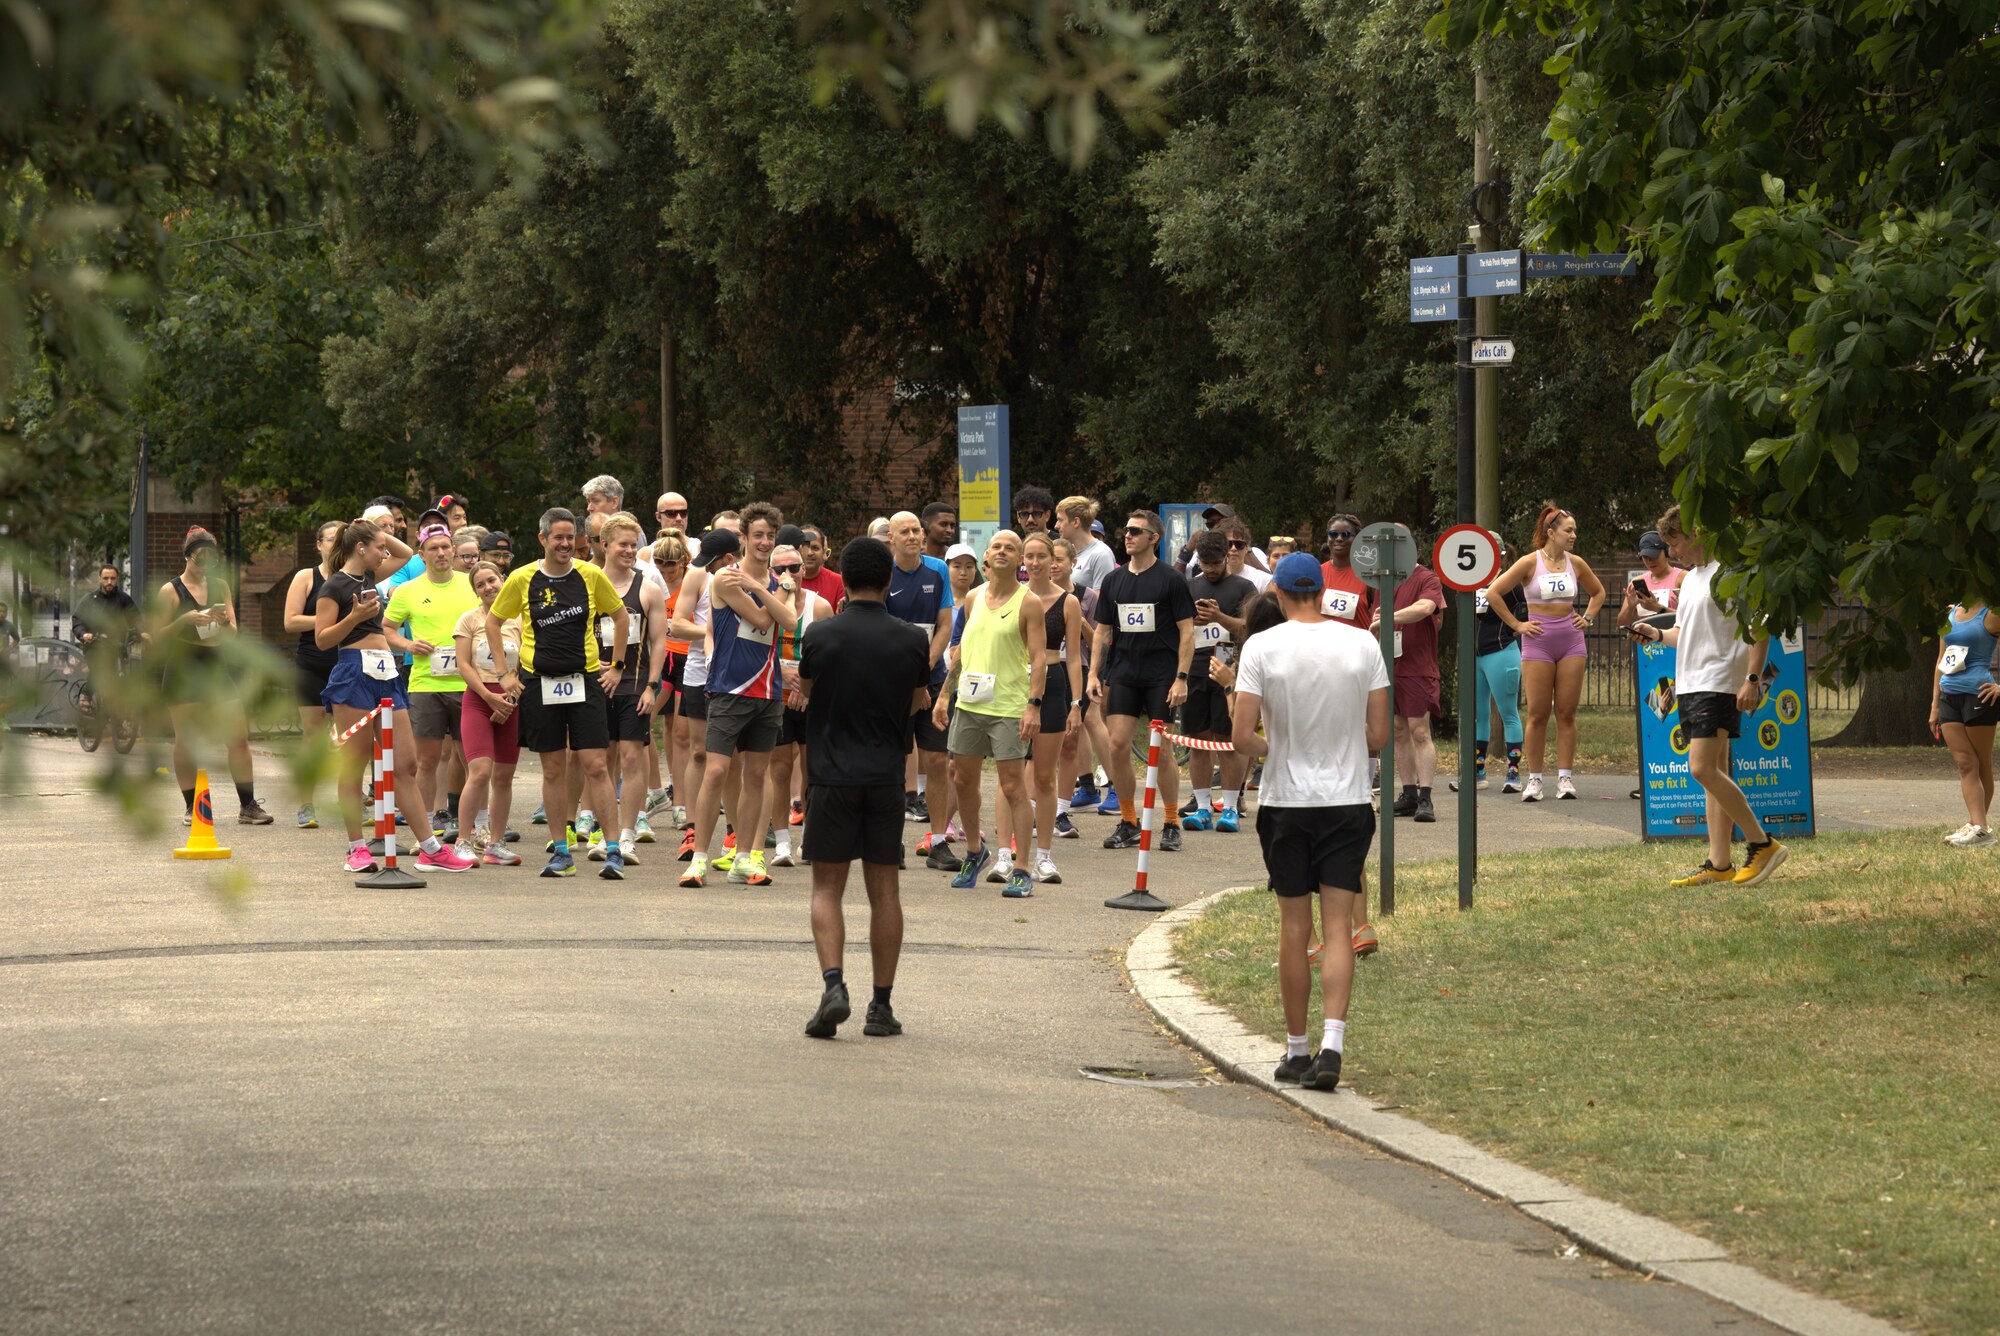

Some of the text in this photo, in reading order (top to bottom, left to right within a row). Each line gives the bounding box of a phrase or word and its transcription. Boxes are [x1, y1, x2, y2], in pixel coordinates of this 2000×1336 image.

[1564, 260, 1623, 271] Regent's Cana
[1493, 345, 1507, 357] Café
[960, 431, 984, 443] Victoria Park
[1457, 545, 1476, 571] 5
[1548, 580, 1565, 592] 76
[1330, 598, 1347, 611] 43
[537, 606, 582, 628] Run&Frite
[1128, 613, 1144, 625] 64
[1203, 627, 1220, 639] 10
[377, 659, 385, 672] 4
[441, 656, 457, 668] 71
[553, 682, 573, 696] 40
[970, 682, 978, 695] 7
[1648, 761, 1688, 774] You find
[1736, 757, 1791, 770] You find it,
[1649, 776, 1687, 789] we fix it
[1738, 773, 1778, 786] we fix it
